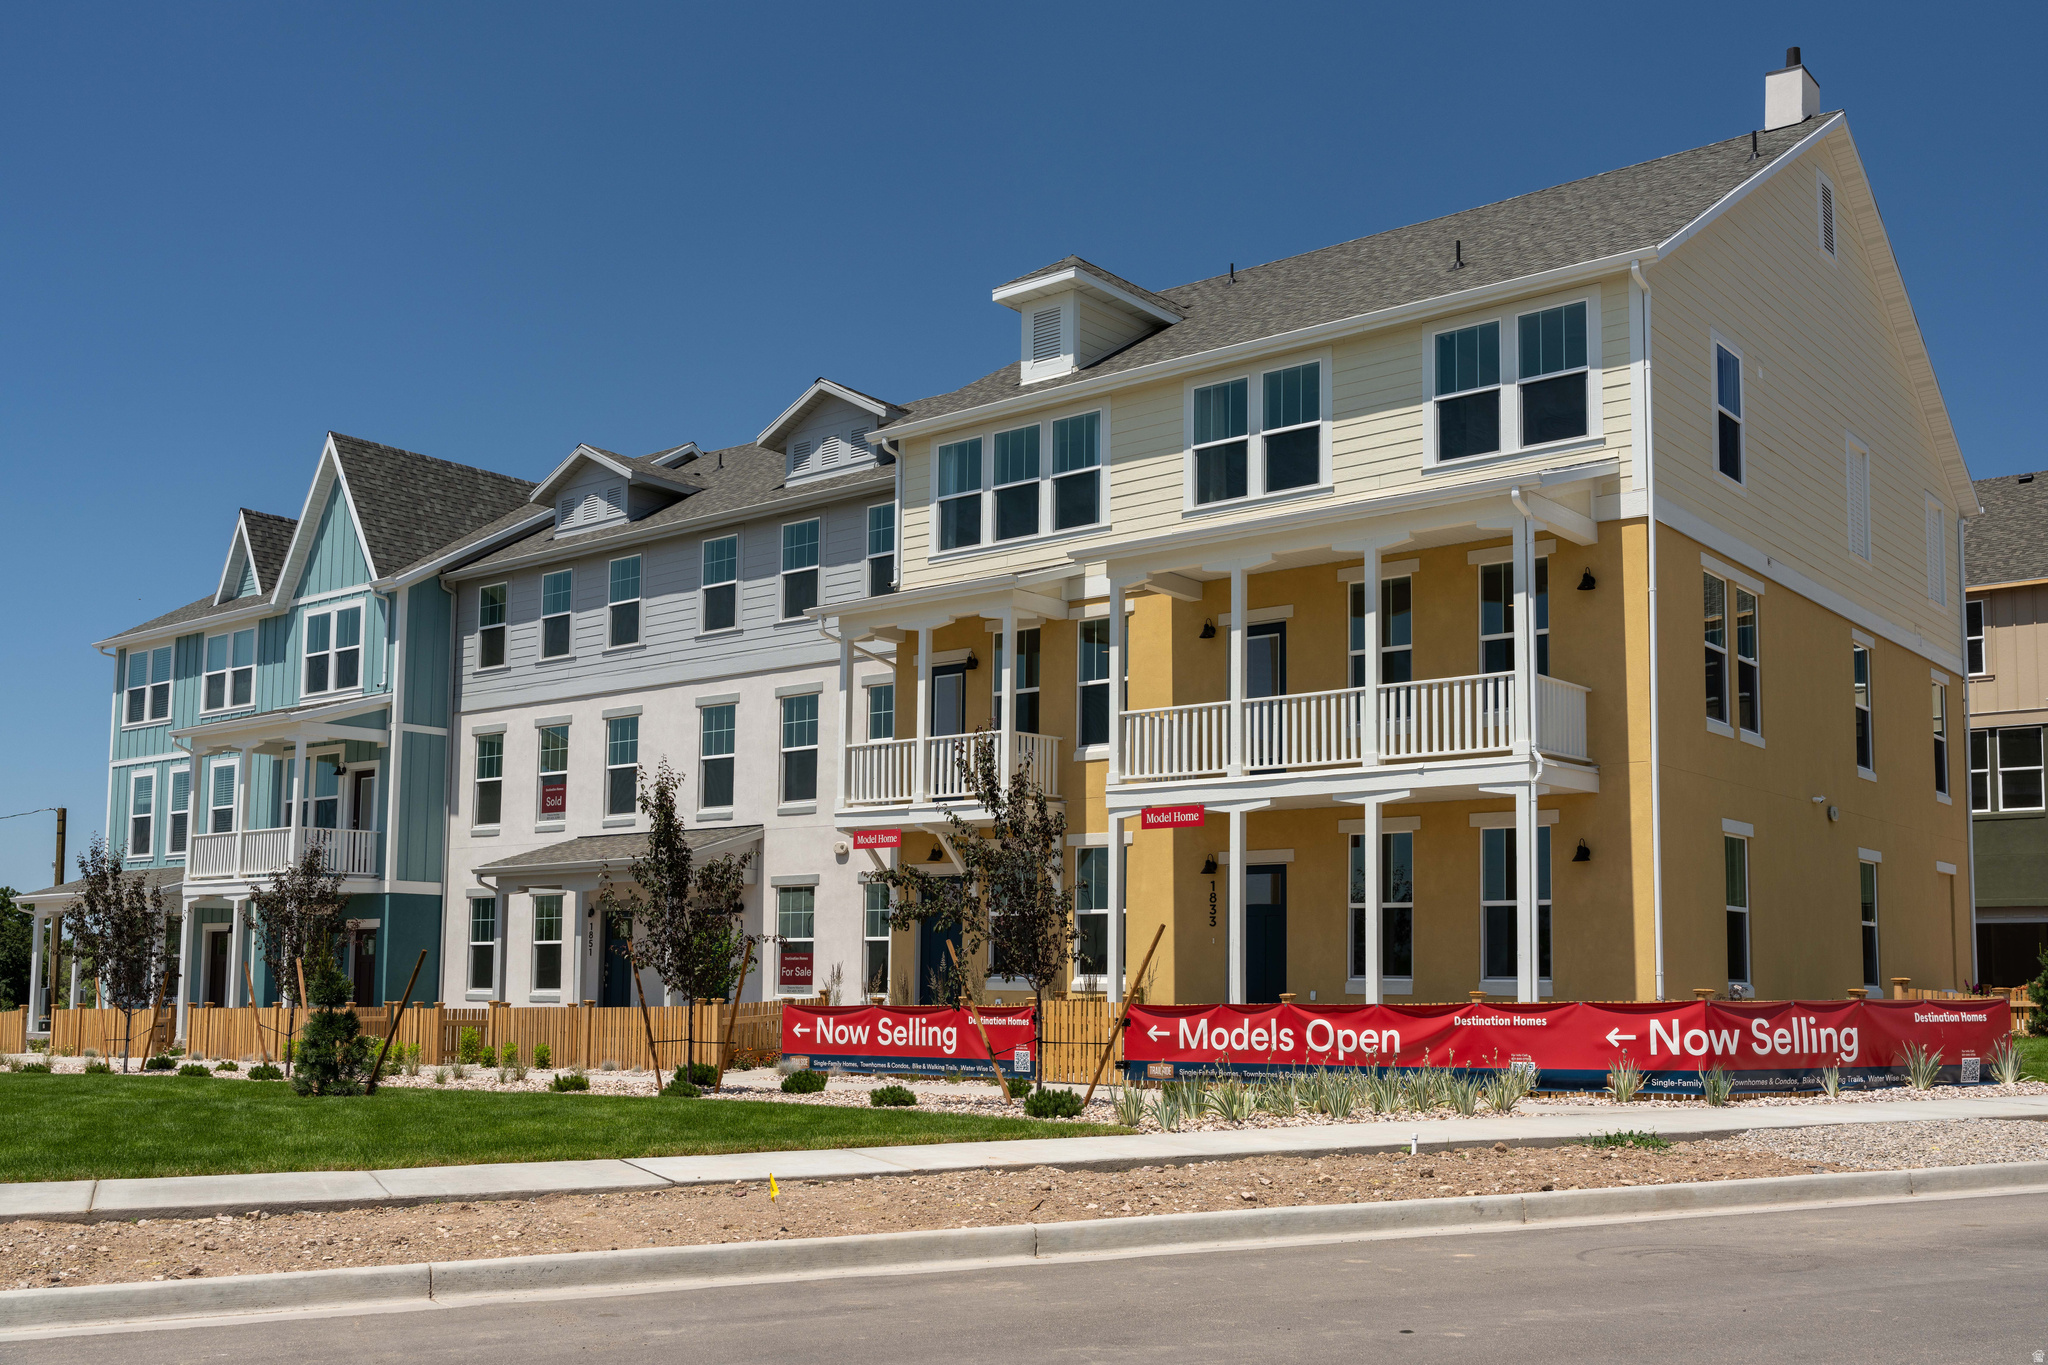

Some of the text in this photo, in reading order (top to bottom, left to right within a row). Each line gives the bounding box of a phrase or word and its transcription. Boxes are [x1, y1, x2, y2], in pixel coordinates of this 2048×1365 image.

[546, 796, 562, 806] Sold
[1146, 812, 1199, 823] Model Home
[857, 834, 897, 844] Model Home
[781, 967, 811, 976] For Sale
[968, 1016, 1029, 1026] Detination Homes
[1454, 1015, 1547, 1026] Destination Homes
[1914, 1012, 1987, 1022] Destination Homes
[816, 1017, 957, 1054] Now Selling
[1179, 1018, 1400, 1060] Models Open
[1650, 1016, 1858, 1062] Now Selling
[1651, 1078, 1703, 1088] Single-Family
